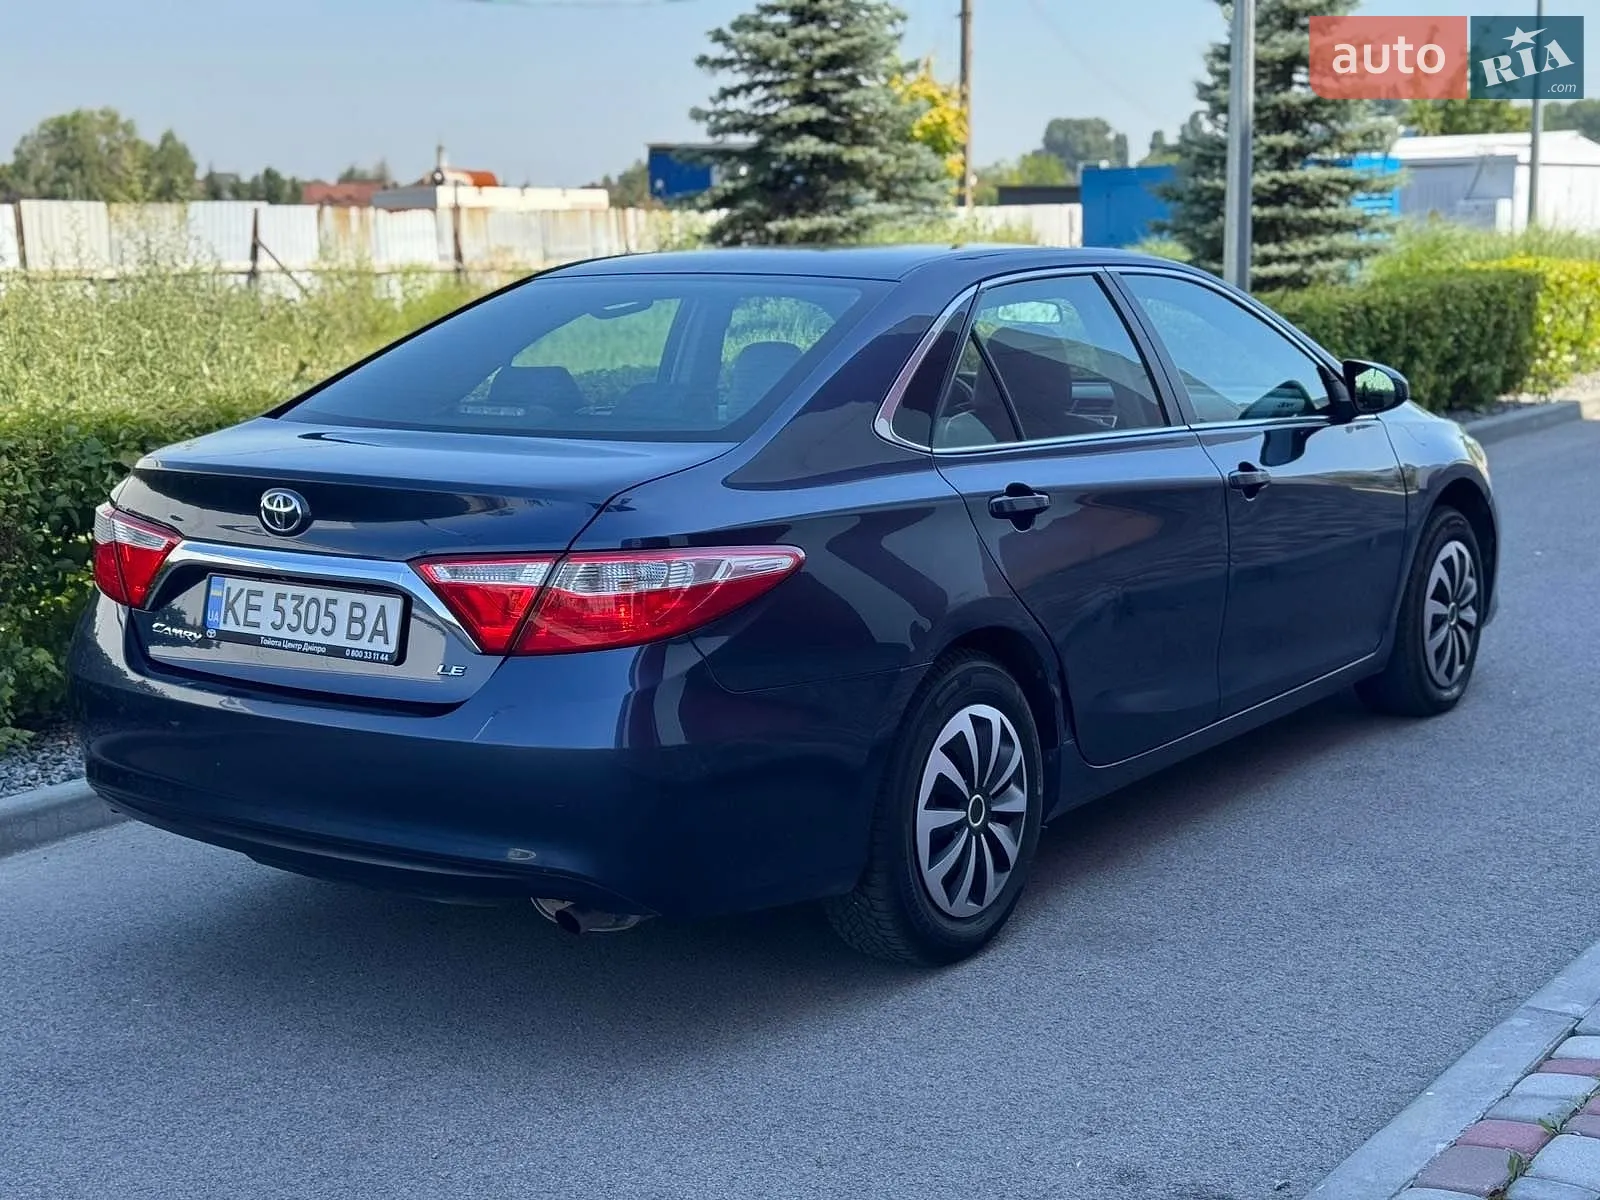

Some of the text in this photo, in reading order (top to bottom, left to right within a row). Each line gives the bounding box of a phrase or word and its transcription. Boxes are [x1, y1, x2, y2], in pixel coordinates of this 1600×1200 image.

[207, 609, 219, 625] UA
[222, 585, 390, 645] KE 5305 BA
[152, 622, 203, 642] CAMRY
[345, 648, 351, 657] 0
[436, 663, 467, 677] LE
